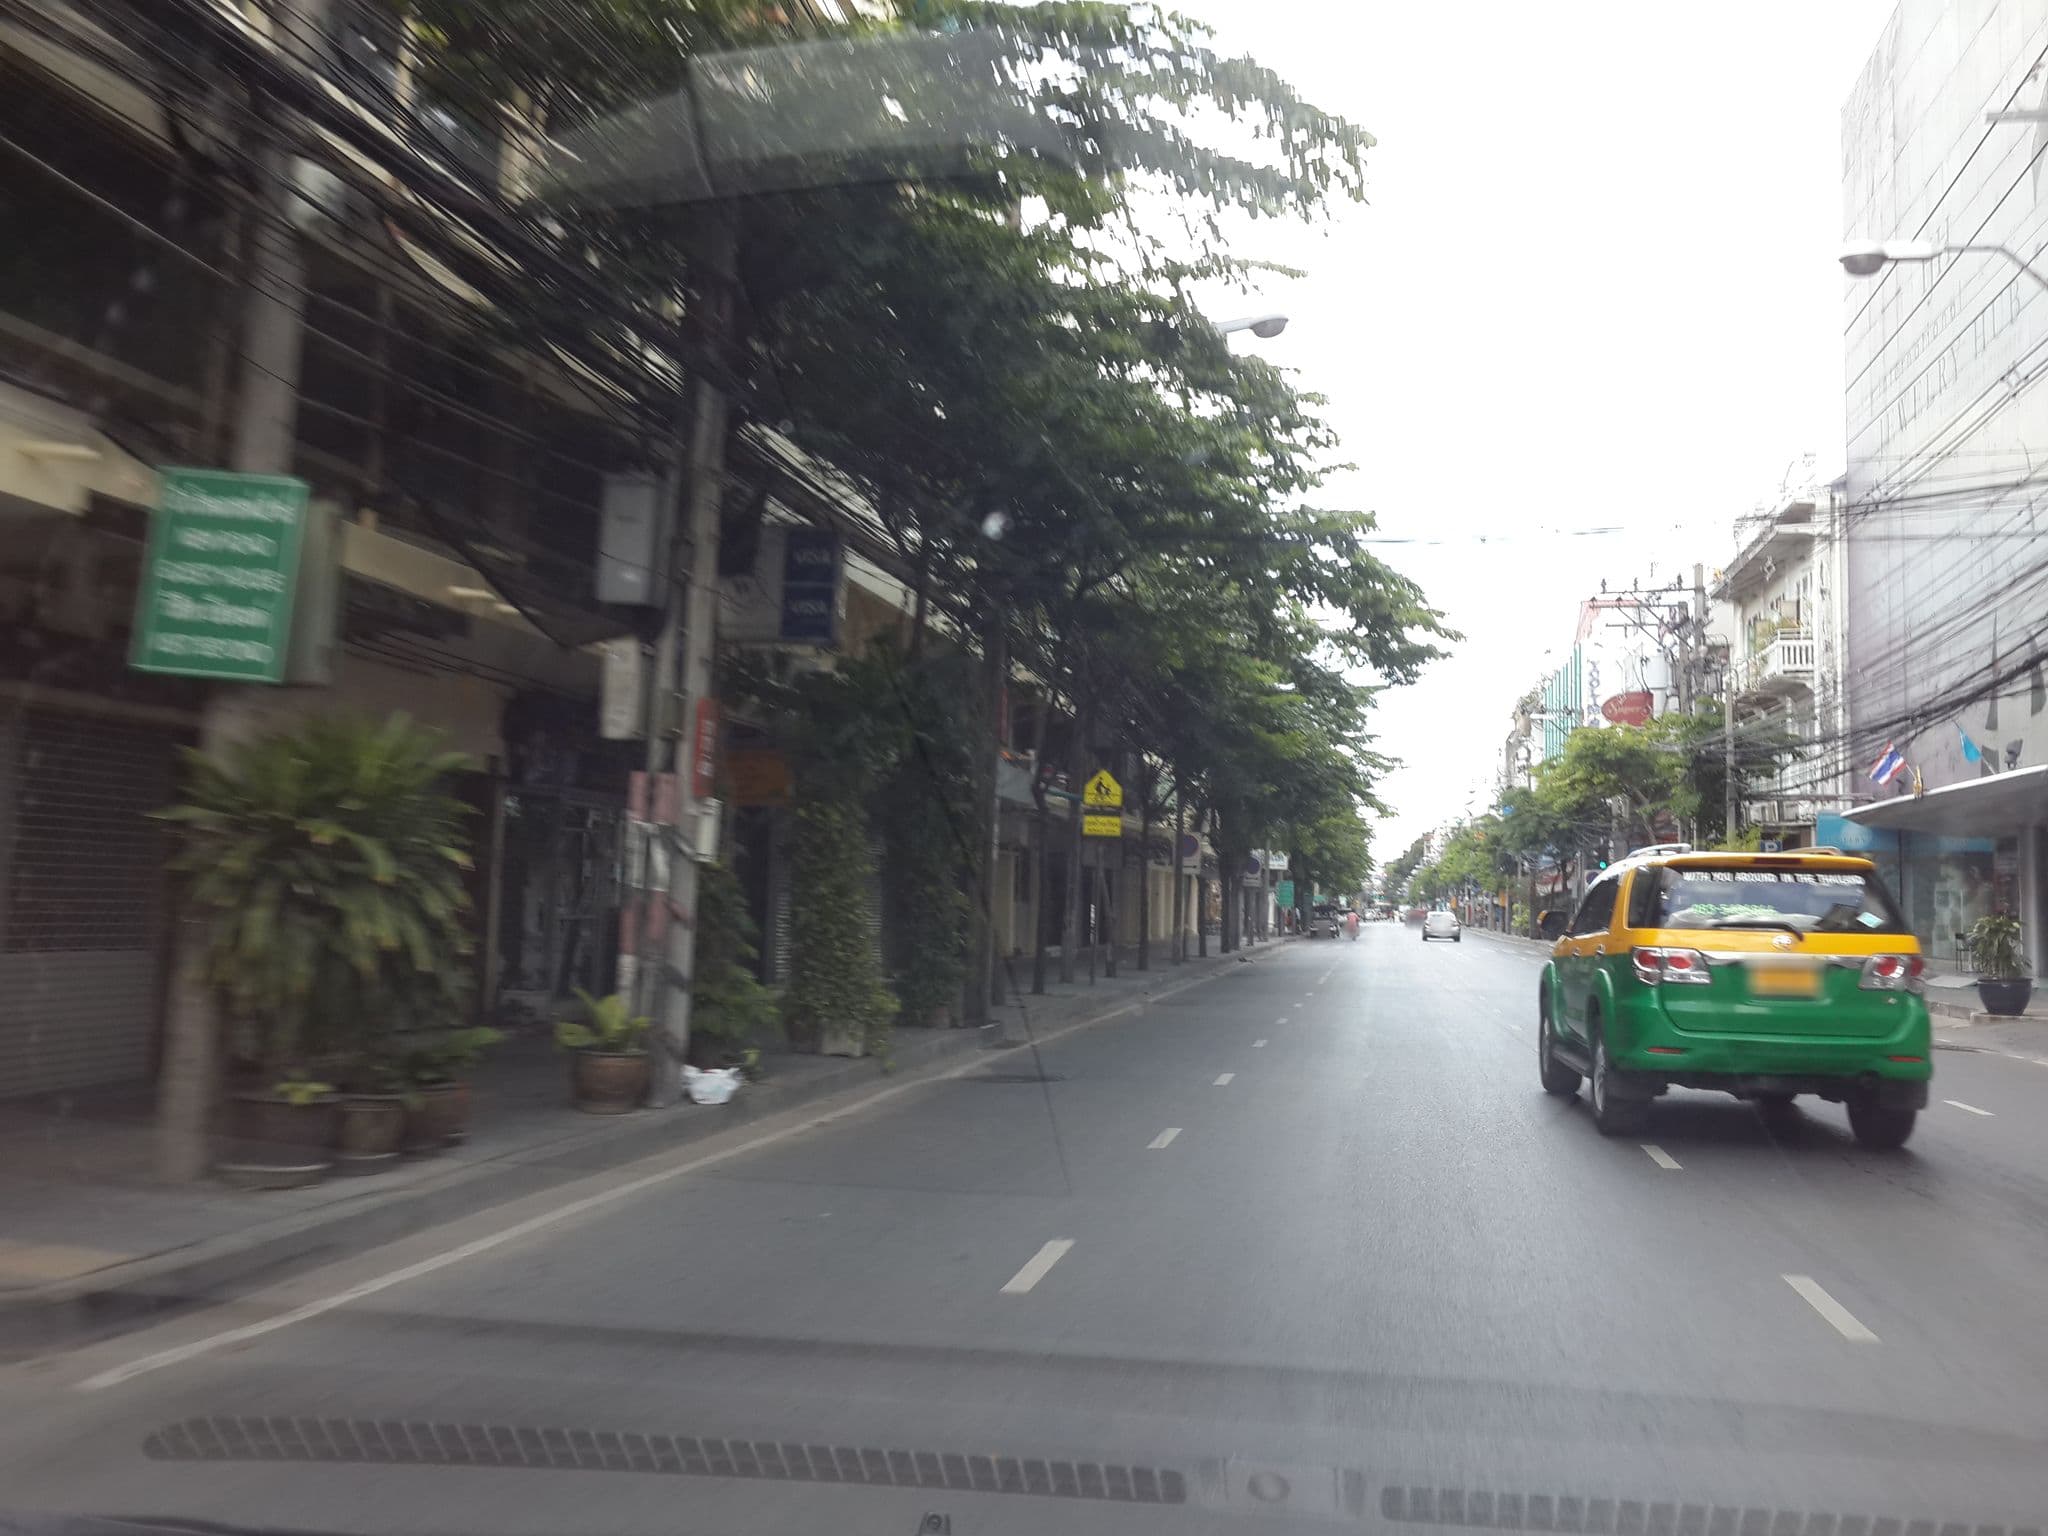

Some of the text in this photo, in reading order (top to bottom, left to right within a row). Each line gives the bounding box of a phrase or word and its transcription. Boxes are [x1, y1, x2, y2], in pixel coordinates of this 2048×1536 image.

[1682, 872, 1711, 881] WITH
[1711, 872, 1733, 881] YOU
[1735, 872, 1778, 882] AROUND
[1779, 873, 1794, 882] IN
[1794, 873, 1816, 884] THE
